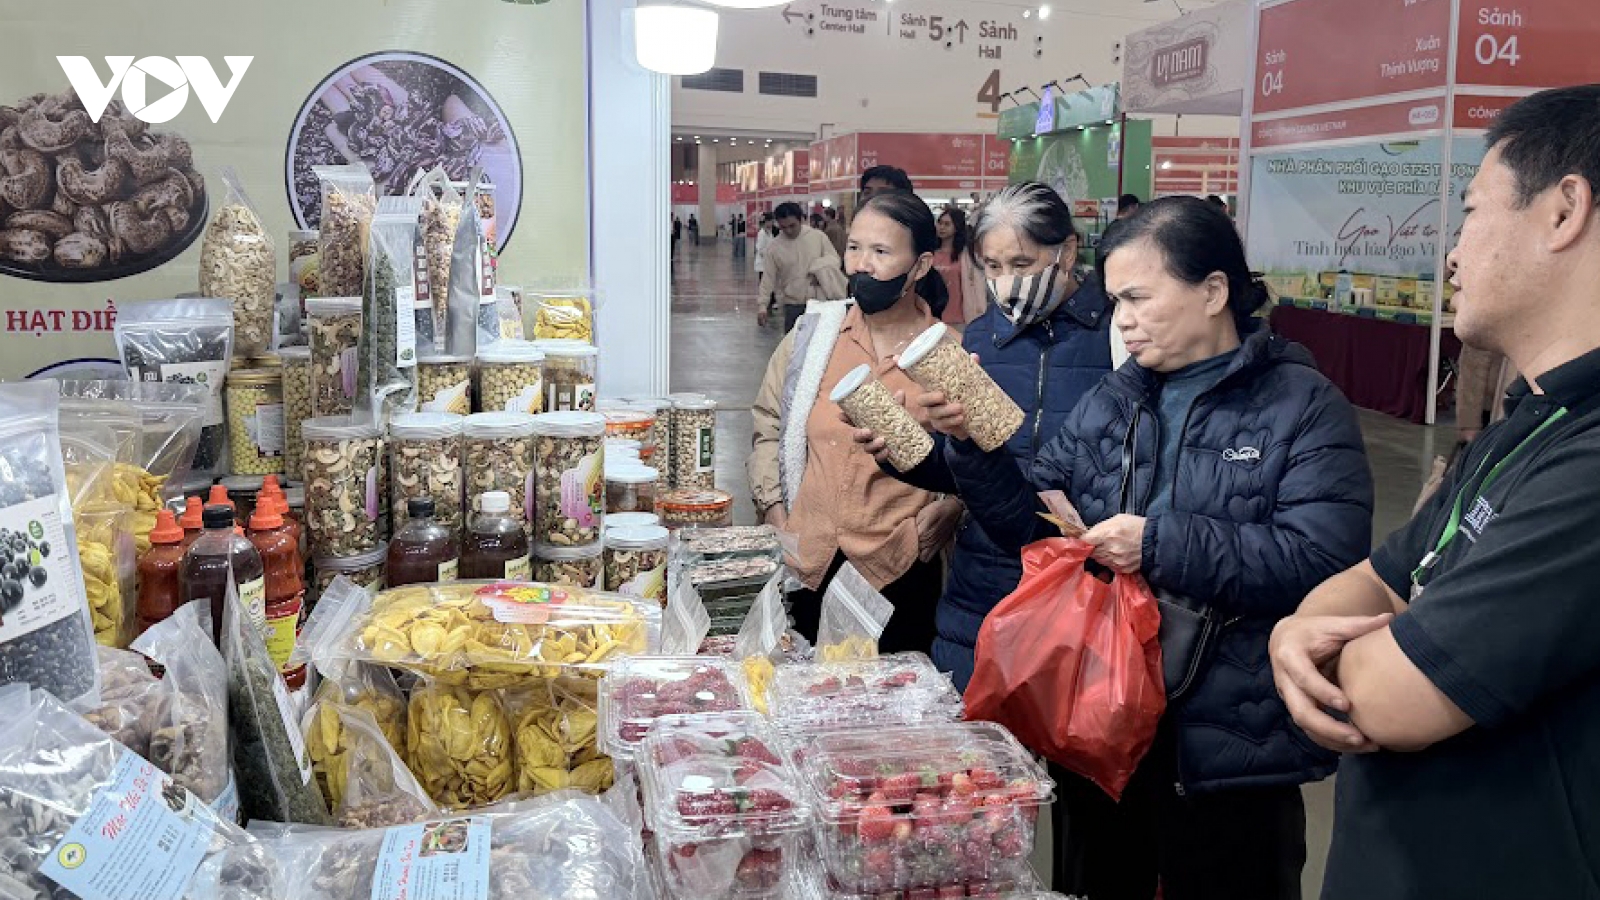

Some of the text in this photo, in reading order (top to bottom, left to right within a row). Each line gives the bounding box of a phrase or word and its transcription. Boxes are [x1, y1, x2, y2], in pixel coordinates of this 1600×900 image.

[820, 4, 877, 21] Trung tâm
[901, 13, 927, 27] Sảnh
[1478, 7, 1521, 27] Sảnh
[820, 21, 865, 34] Center Hall
[900, 29, 916, 39] Hall
[929, 16, 943, 41] 5
[979, 20, 1018, 40] Sảnh
[979, 44, 1002, 59] Hall
[1265, 49, 1286, 66] Sảnh
[1475, 34, 1520, 66] 04
[1380, 57, 1439, 79] Thịnh Vượng
[977, 69, 1001, 113] 4
[1262, 69, 1284, 97] 04
[988, 159, 1004, 171] 04
[1268, 157, 1294, 174] NHÀ
[1300, 158, 1333, 174] PHÂN
[1336, 158, 1367, 175] PHỐI
[1369, 162, 1400, 178] GẠO
[1338, 181, 1364, 194] KHU
[1368, 180, 1394, 197] VỰC
[1397, 180, 1425, 195] PHÍA
[1293, 241, 1329, 256] Tinh
[1389, 246, 1415, 259] gạo
[5, 299, 118, 337] HẠT ĐIỀ
